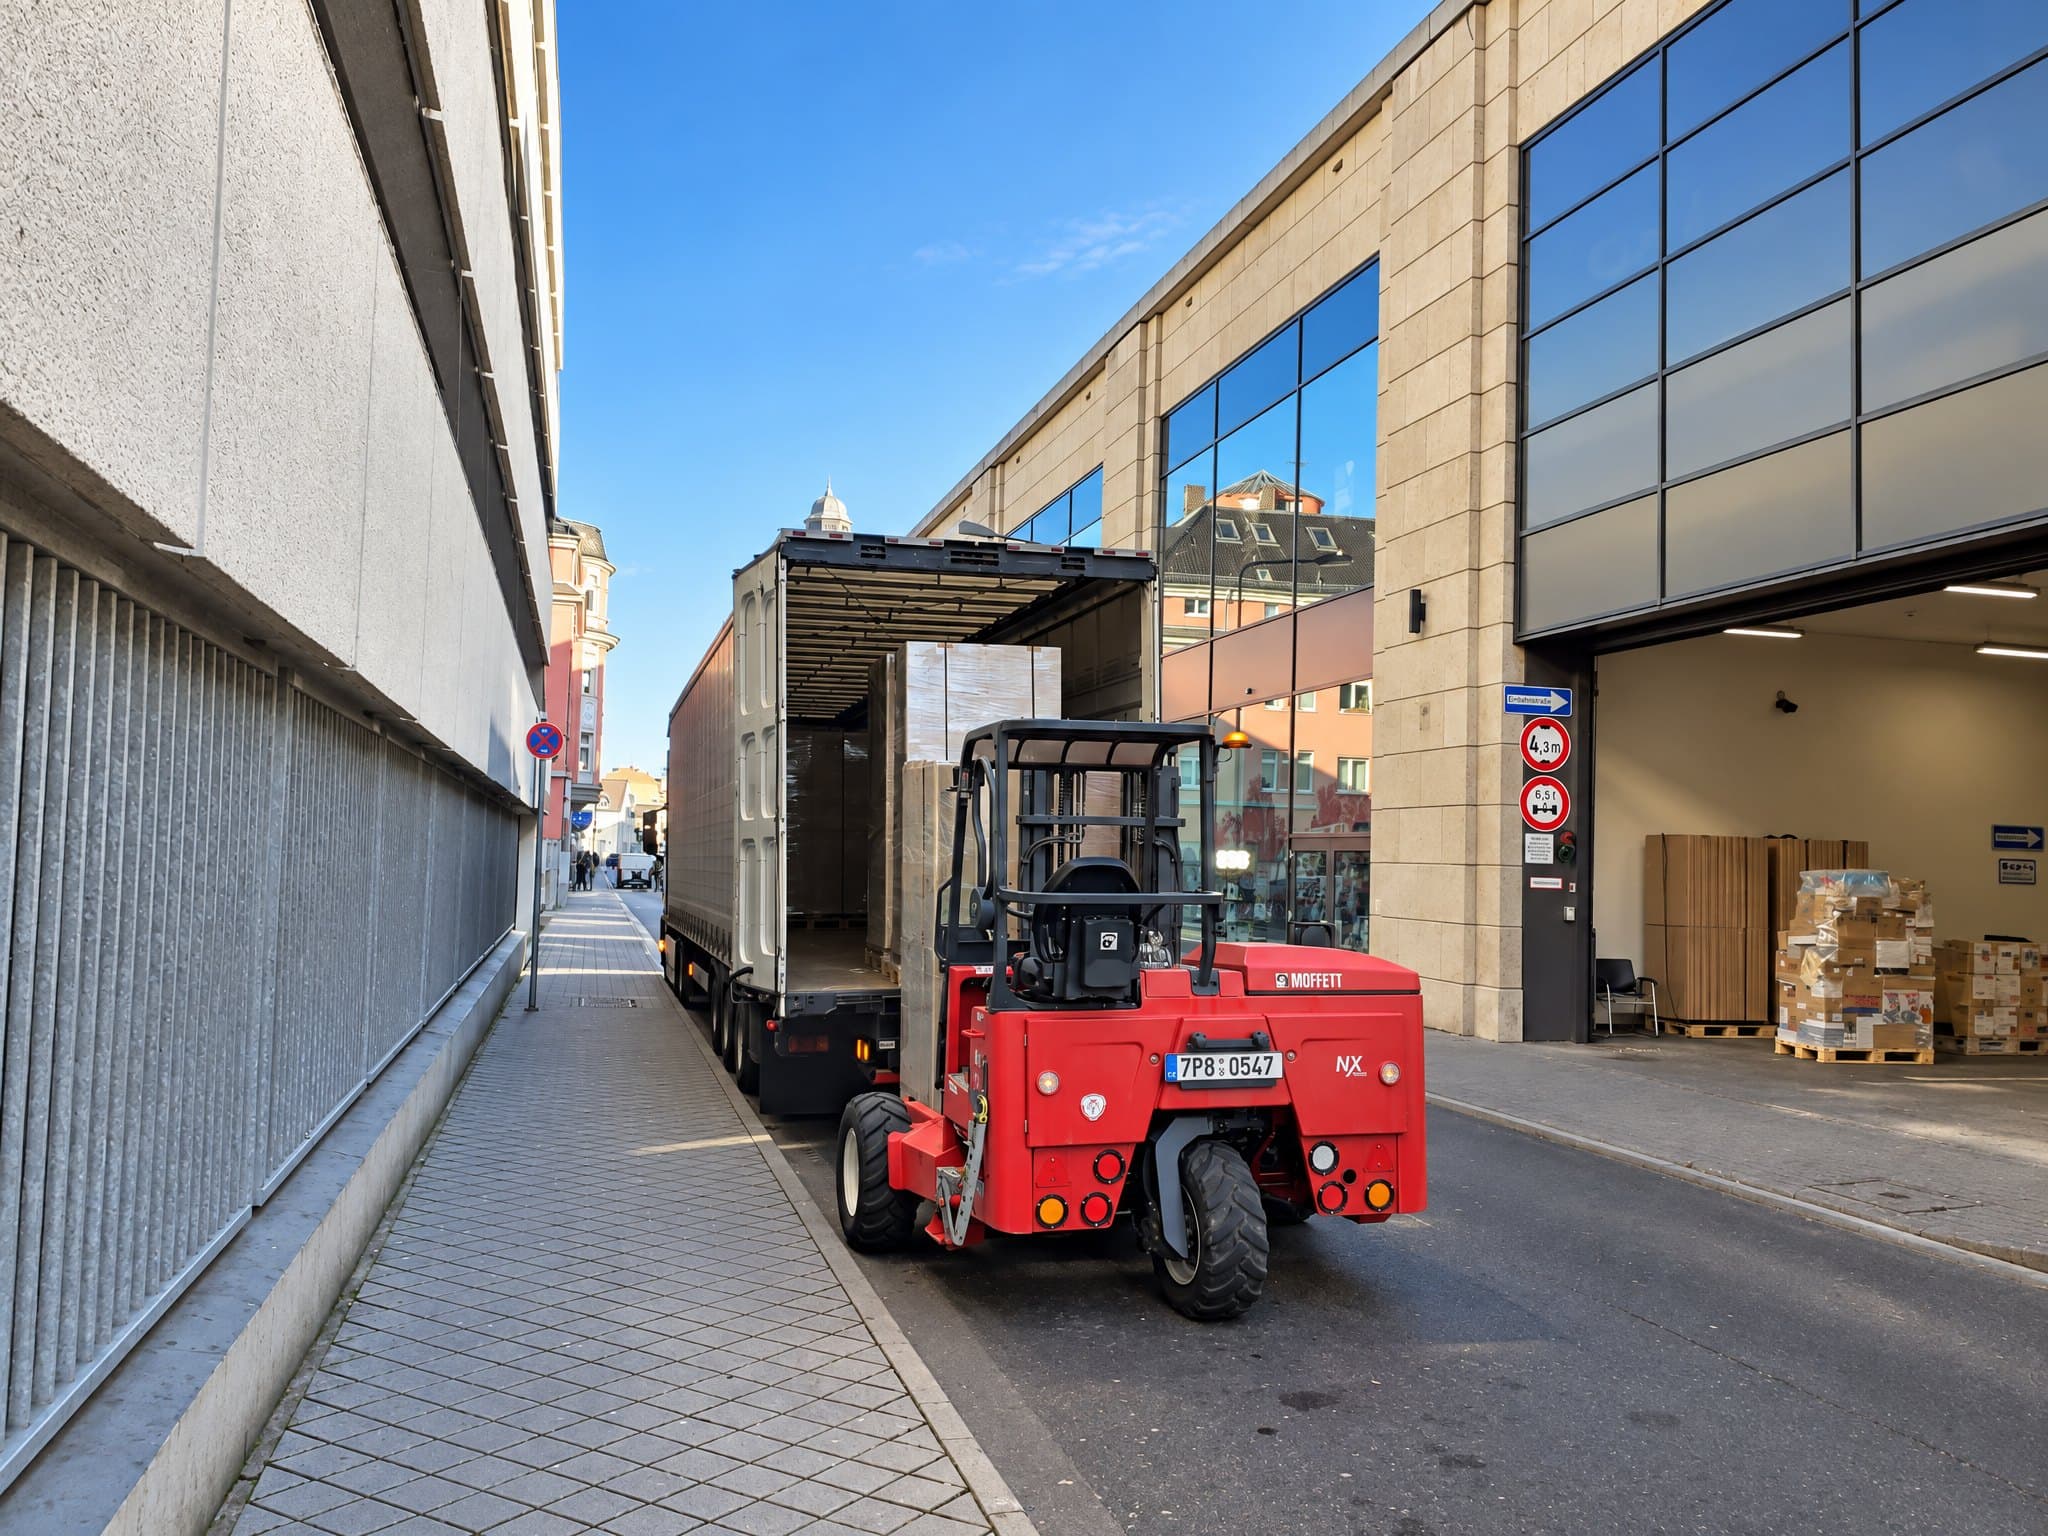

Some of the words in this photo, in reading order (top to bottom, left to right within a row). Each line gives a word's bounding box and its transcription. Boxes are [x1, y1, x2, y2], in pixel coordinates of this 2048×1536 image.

[1529, 735, 1549, 755] 4,3
[1535, 790, 1550, 800] 6,5
[1291, 972, 1342, 988] MOFFETT
[1180, 1057, 1215, 1077] 7P8
[1229, 1056, 1274, 1076] 0547
[1335, 1055, 1363, 1077] NX
